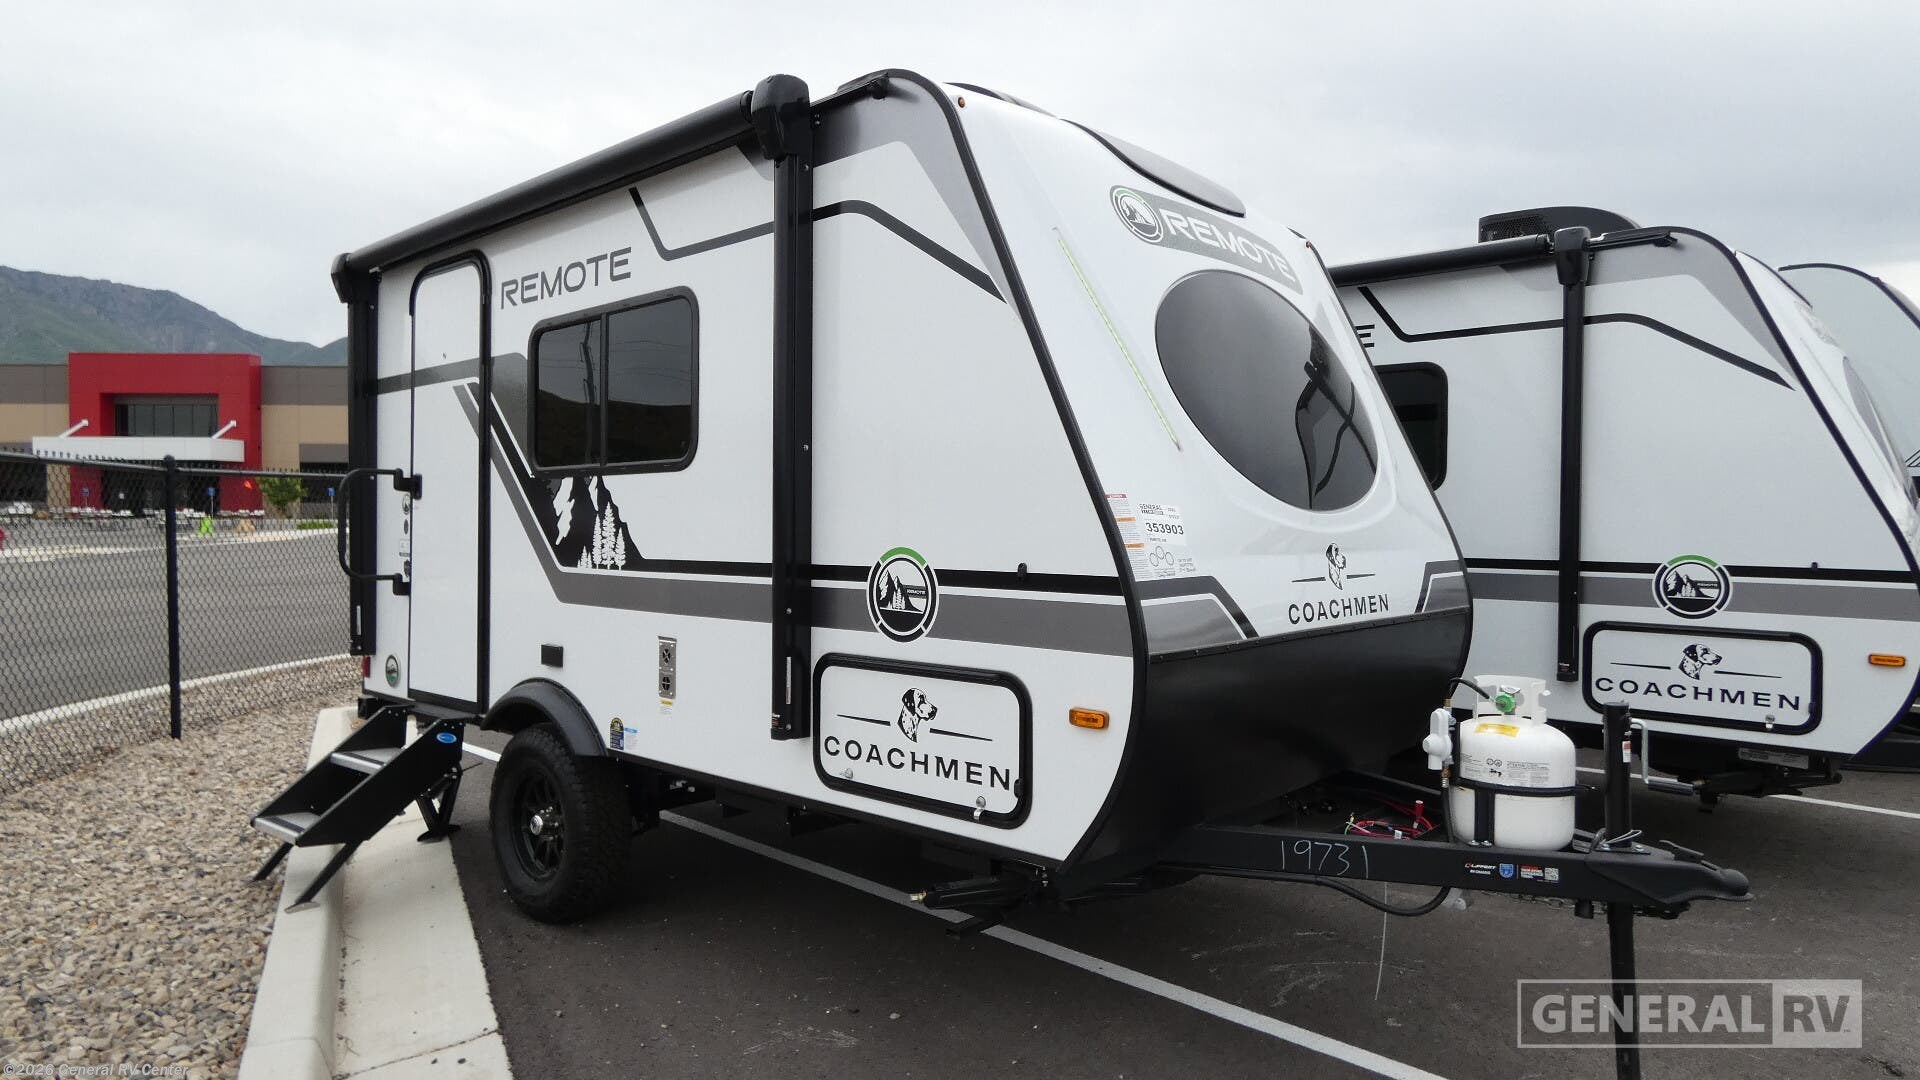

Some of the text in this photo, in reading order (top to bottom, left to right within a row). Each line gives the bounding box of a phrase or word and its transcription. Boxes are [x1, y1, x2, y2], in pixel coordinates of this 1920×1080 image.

[1159, 209, 1295, 282] REMOTE
[500, 246, 632, 310] REMOTE
[1145, 522, 1185, 536] 353903
[1288, 593, 1390, 626] COACHMEN
[1594, 677, 1801, 712] COACHMEN
[824, 735, 1011, 792] COACHMEN
[1281, 839, 1370, 879] 19731
